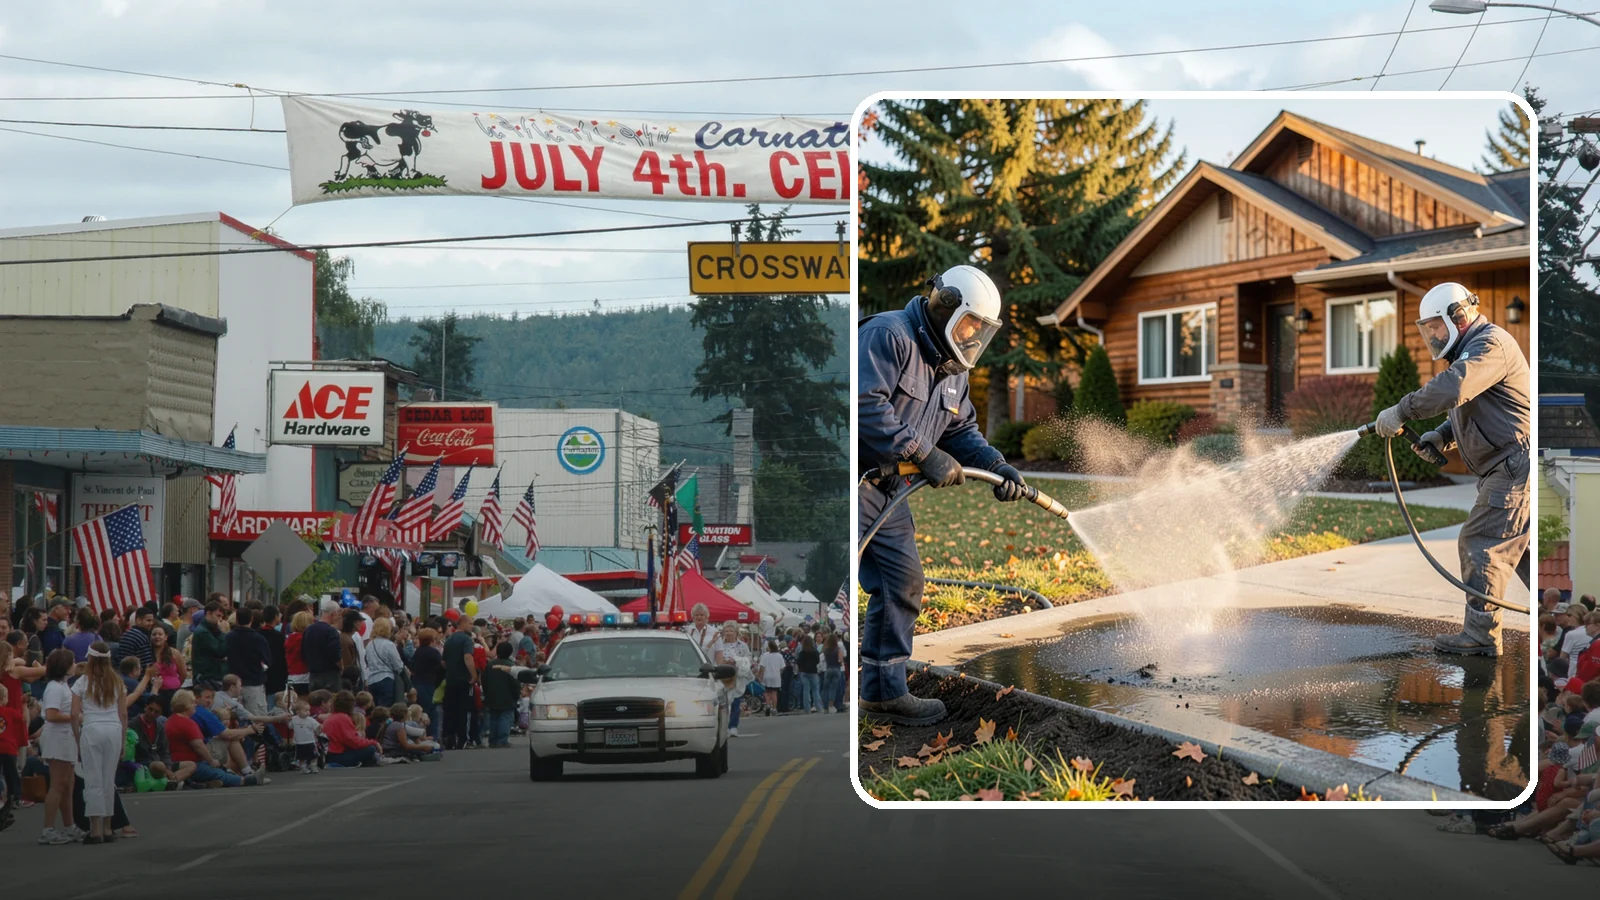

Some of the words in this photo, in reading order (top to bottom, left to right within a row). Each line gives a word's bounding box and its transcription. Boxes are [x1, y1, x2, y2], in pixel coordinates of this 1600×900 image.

[695, 121, 850, 149] Carnat
[481, 141, 604, 192] JULY
[632, 150, 746, 197] 4th.
[697, 254, 850, 280] CROSSWA
[283, 380, 373, 420] ACE
[405, 409, 453, 421] CEDAR
[283, 421, 371, 436] Hardware
[416, 427, 477, 447] Coca-Cola
[83, 486, 94, 494] St.
[95, 485, 124, 494] Vincent
[126, 486, 136, 494] de
[137, 486, 155, 495] Paul
[688, 526, 741, 535] CRNATION
[699, 535, 730, 543] GLASS
